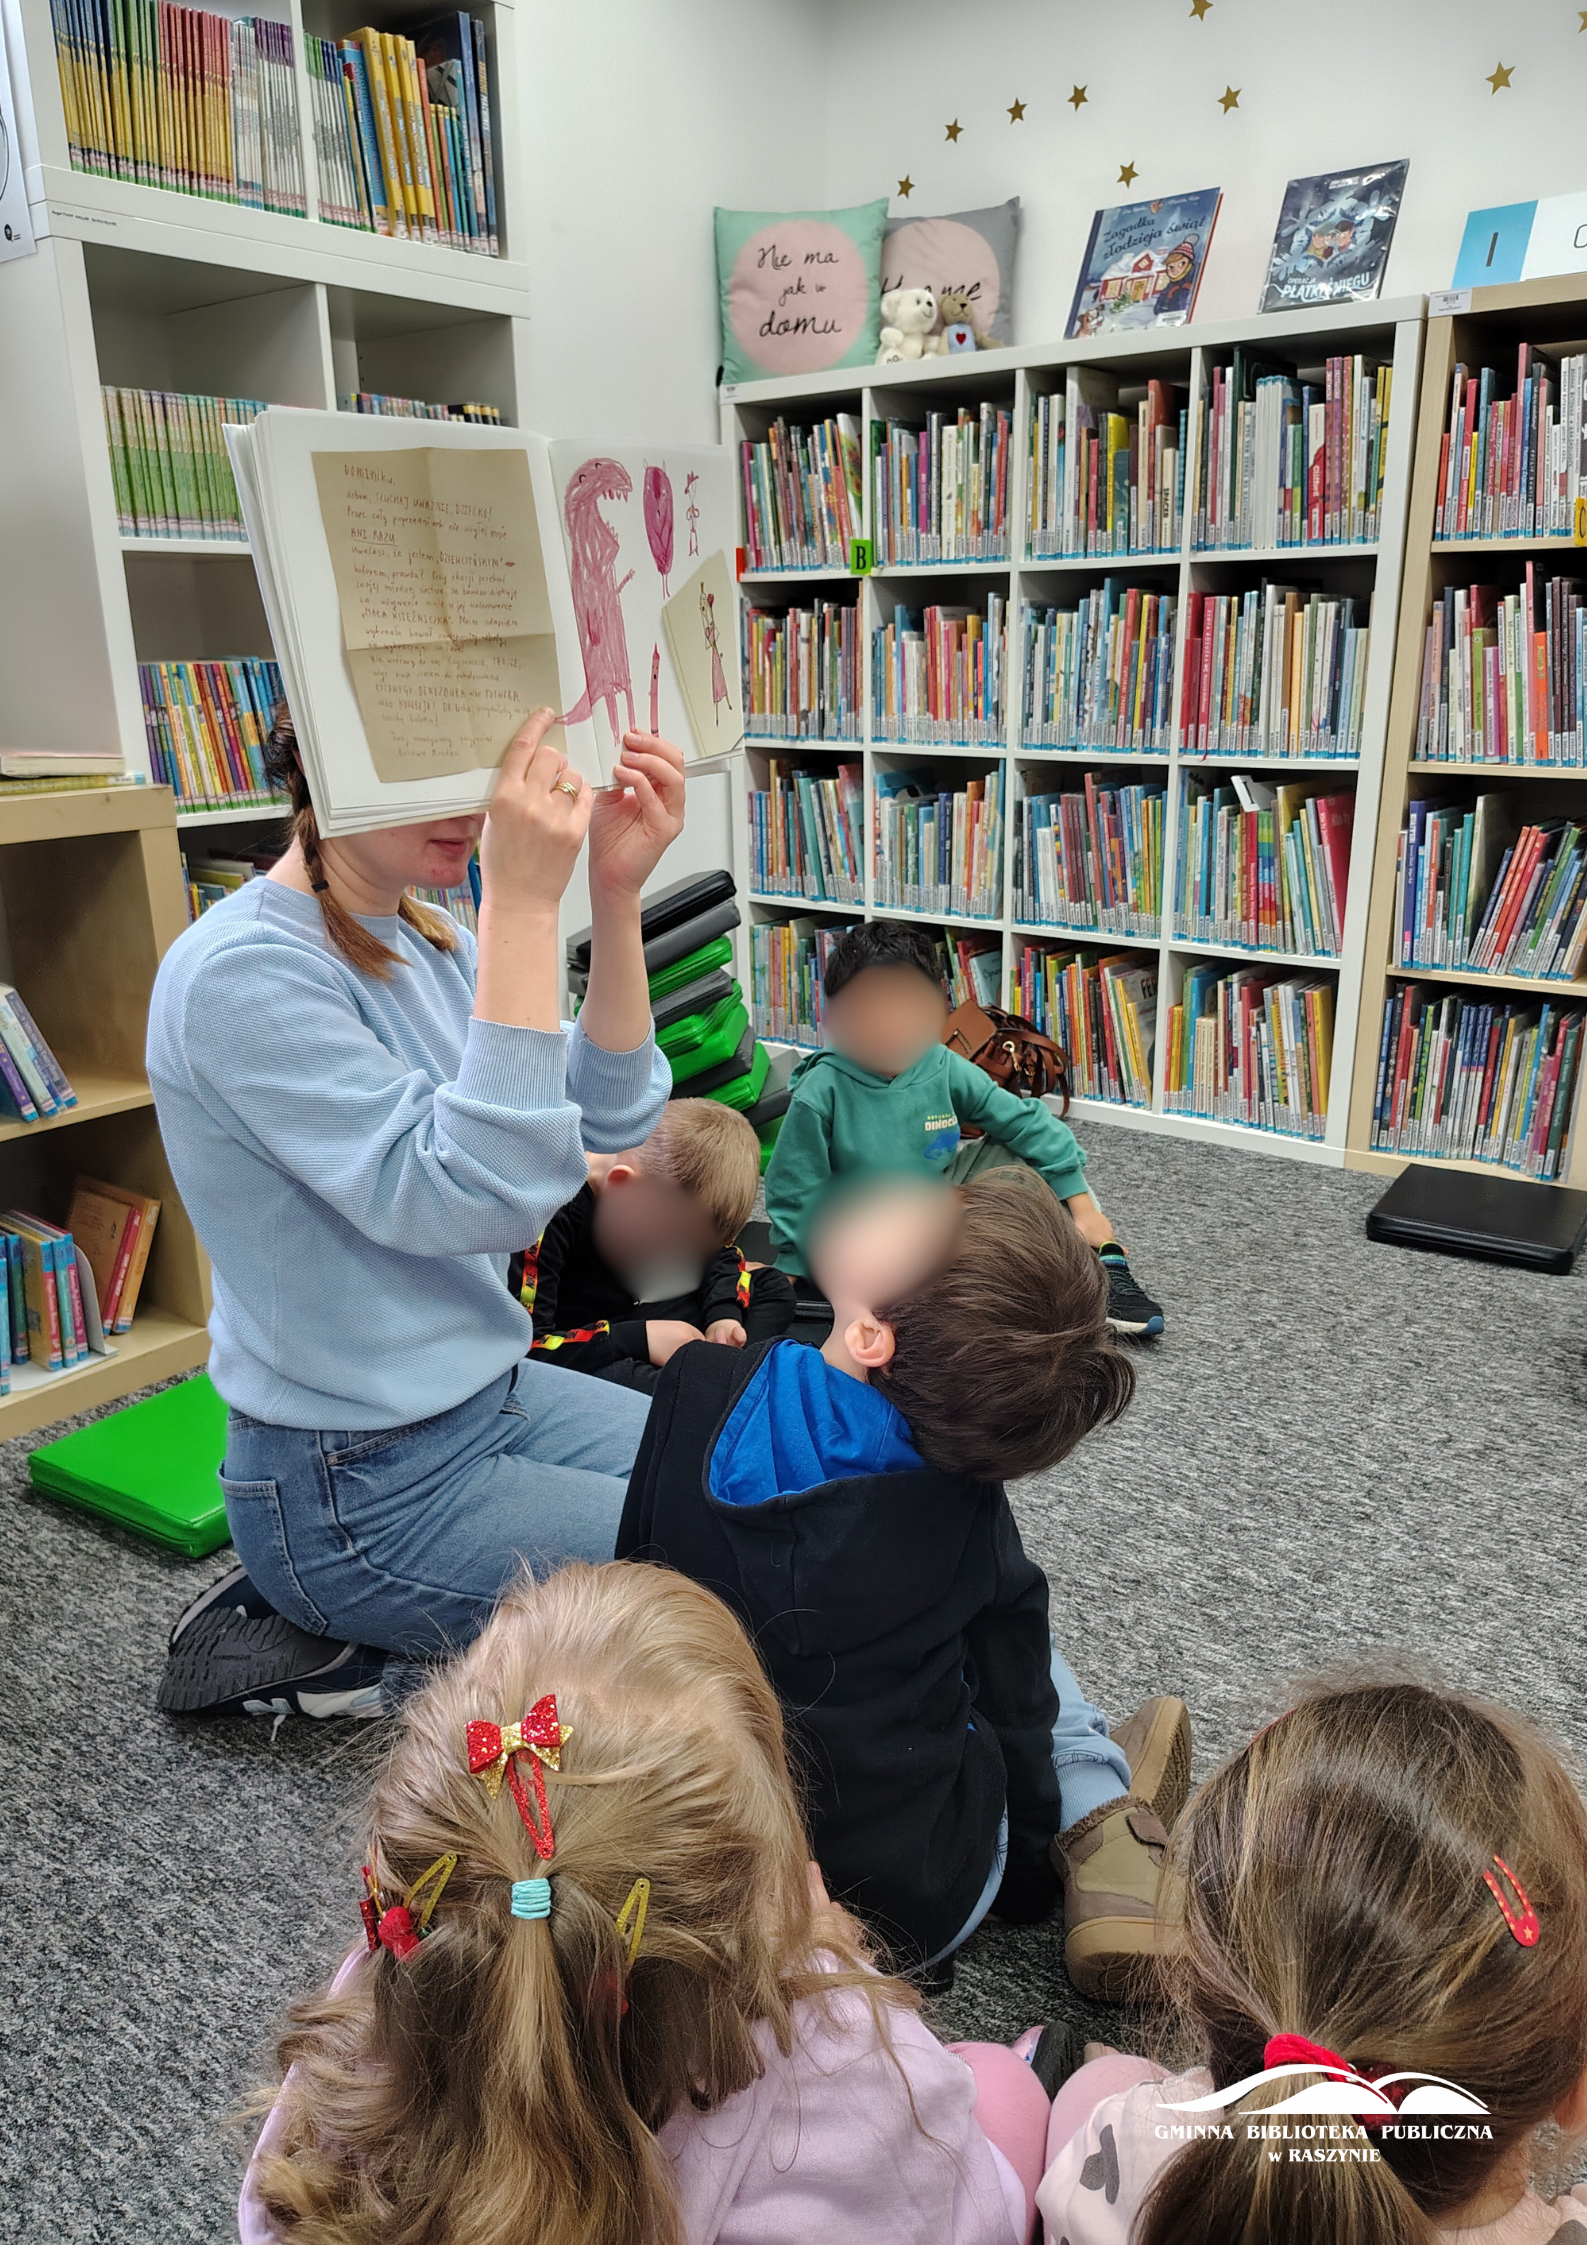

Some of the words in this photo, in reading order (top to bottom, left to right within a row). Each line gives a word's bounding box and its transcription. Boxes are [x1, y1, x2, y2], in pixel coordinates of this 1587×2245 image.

[1103, 217, 1156, 243] Zagadka
[1166, 214, 1206, 236] świąt
[803, 252, 840, 265] ma
[778, 276, 807, 307] jak
[815, 283, 827, 293] w
[759, 310, 843, 337] domu
[855, 545, 867, 570] B
